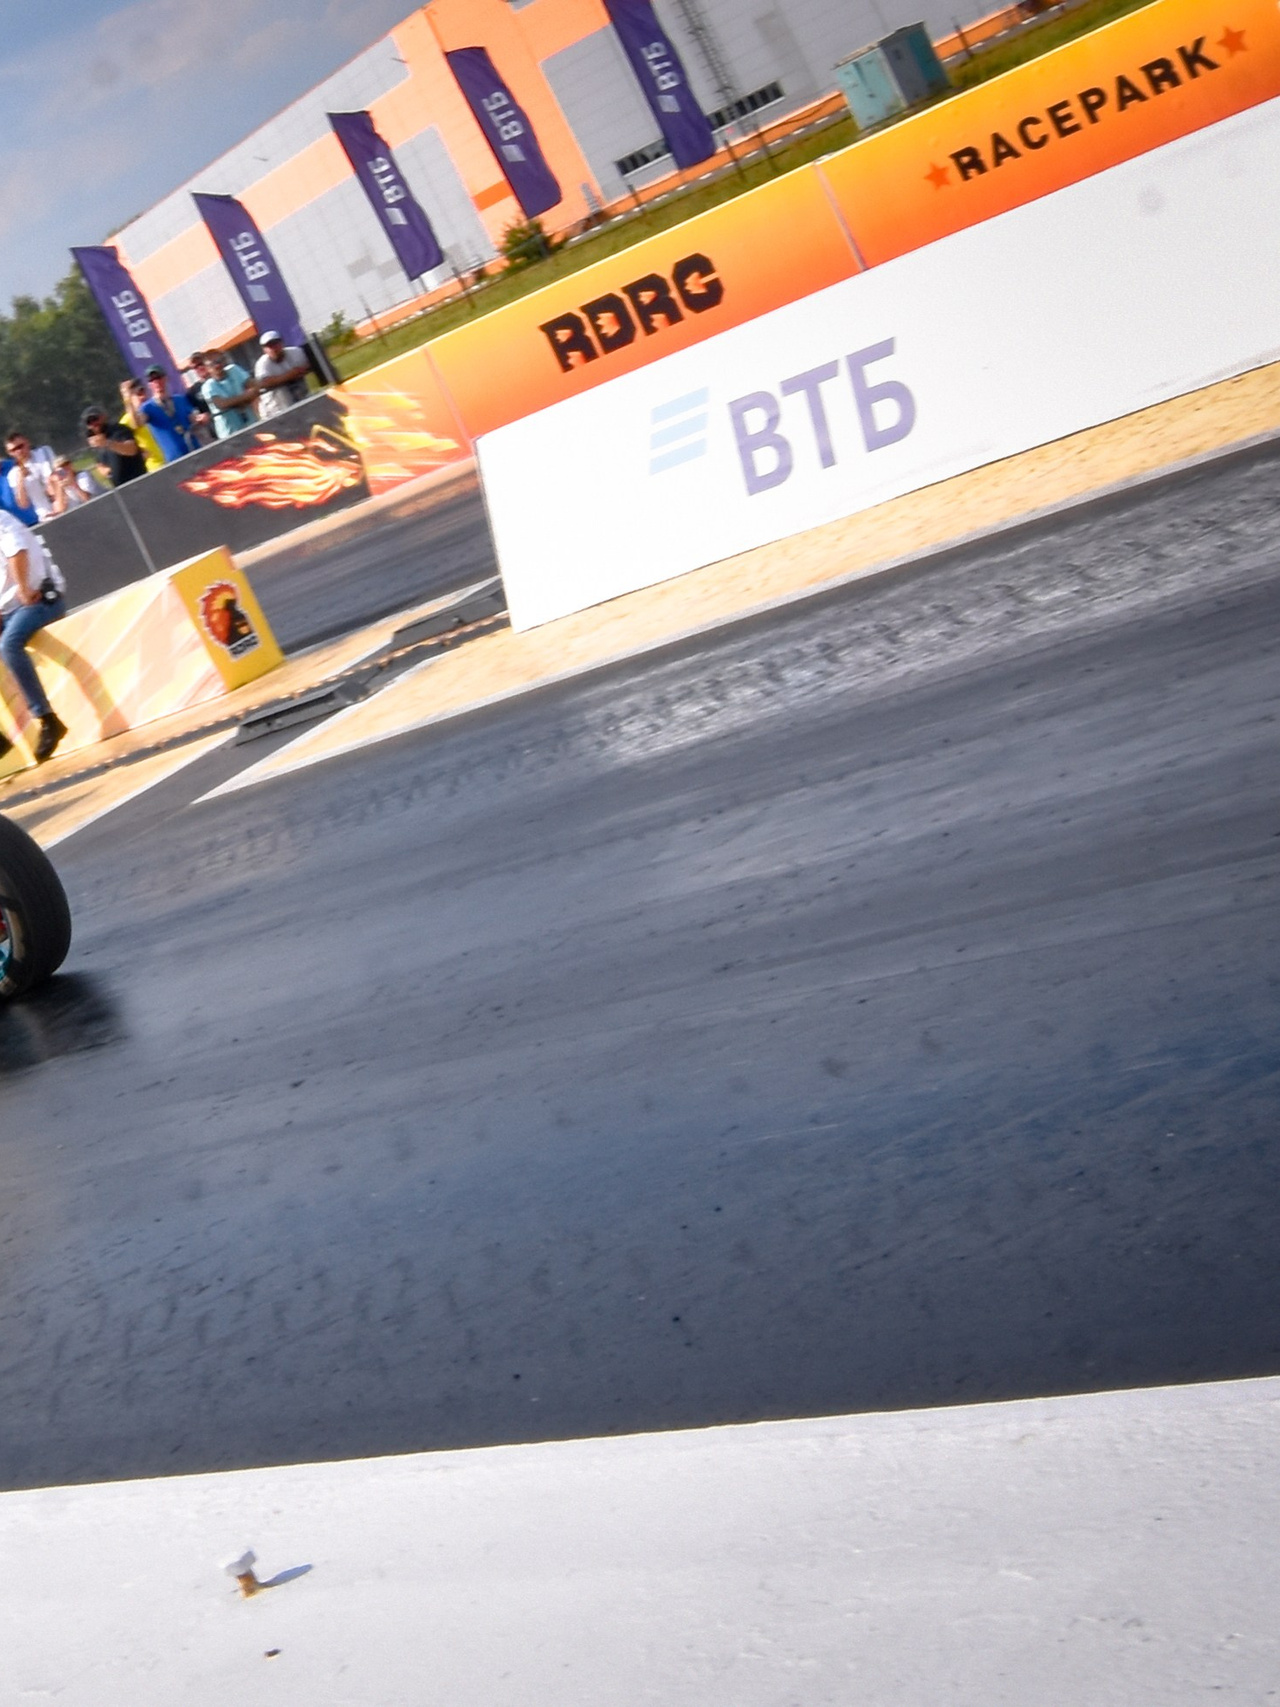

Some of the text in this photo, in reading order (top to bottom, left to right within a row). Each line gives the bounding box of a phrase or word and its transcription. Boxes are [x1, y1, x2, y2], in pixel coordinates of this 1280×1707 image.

[641, 42, 680, 91] ВТБ
[481, 91, 524, 141] ВТБ
[949, 36, 1220, 181] RACEPARK
[367, 157, 406, 204] ВТБ
[229, 232, 270, 281] ВТБ
[111, 290, 152, 337] ВТБ
[727, 337, 917, 496] ВТБ
